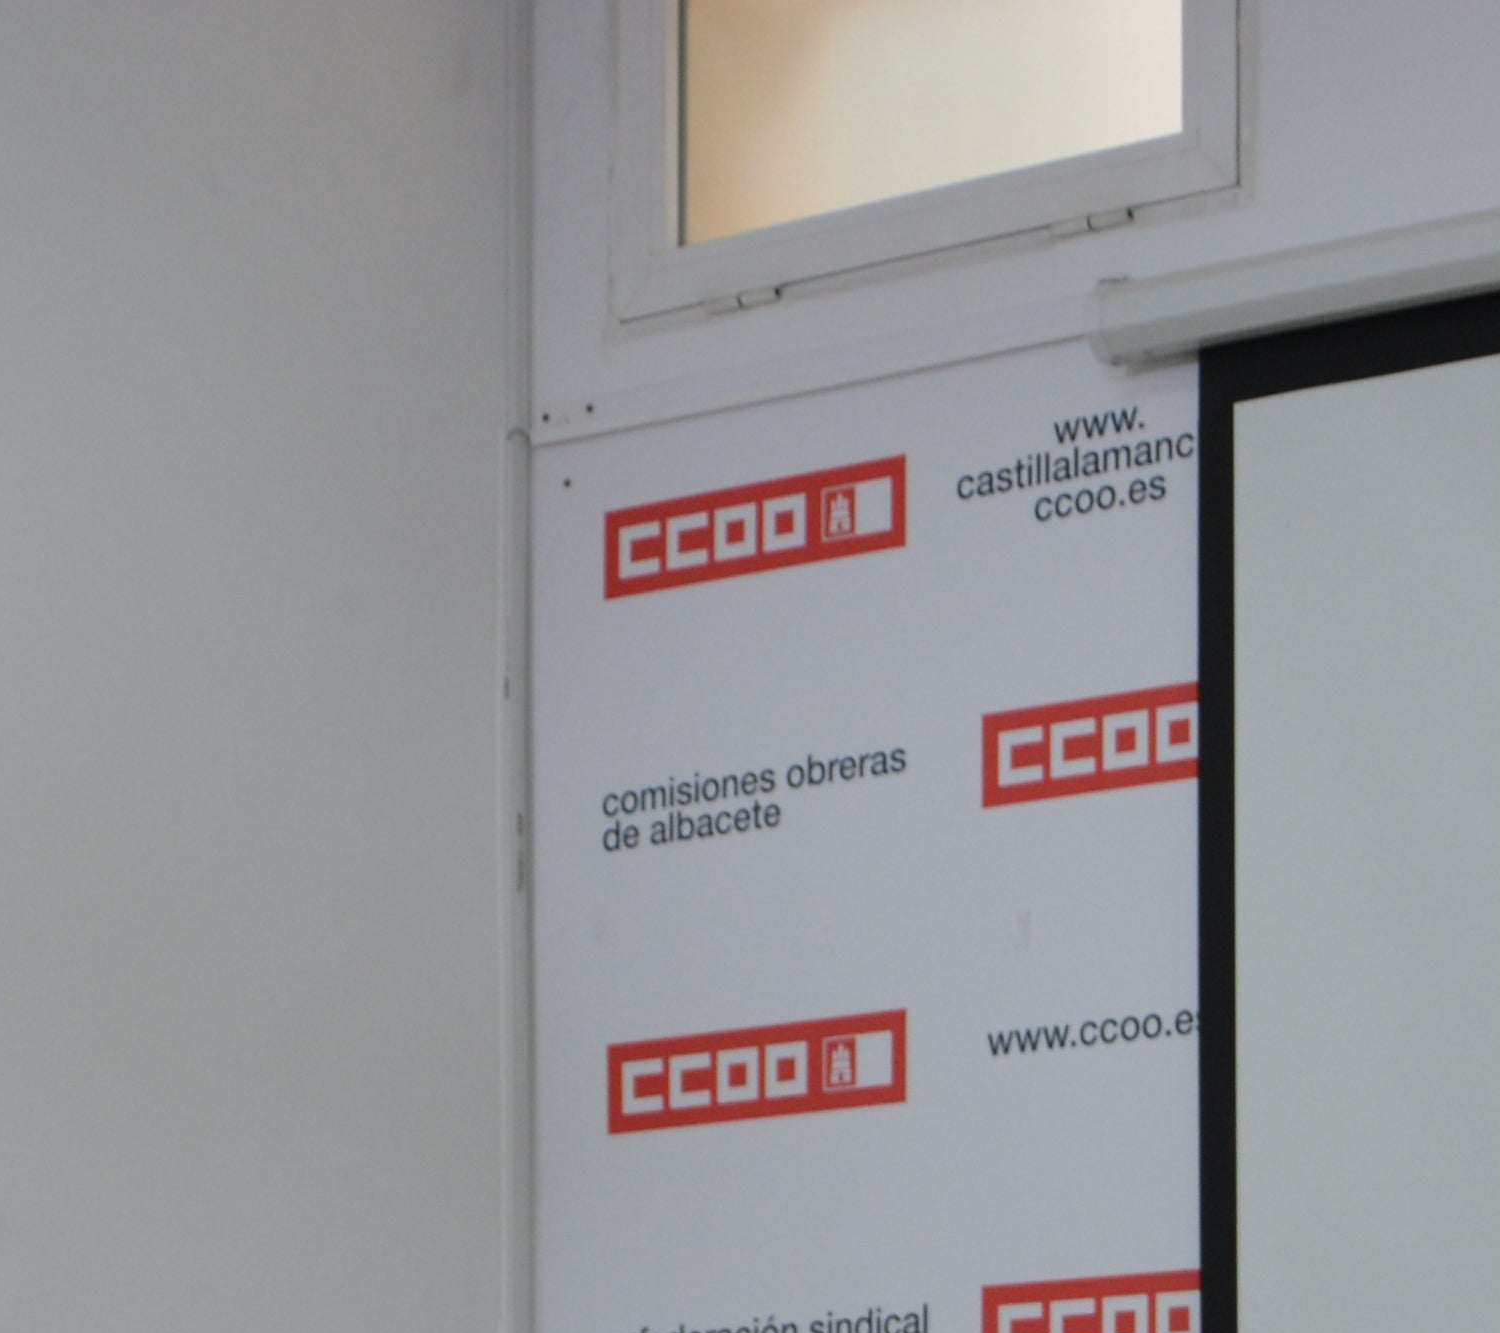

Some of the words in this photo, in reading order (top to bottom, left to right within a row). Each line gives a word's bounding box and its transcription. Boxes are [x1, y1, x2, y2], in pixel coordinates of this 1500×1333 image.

[1053, 406, 1145, 445] www.
[956, 432, 1195, 505] castillalamanc
[1033, 474, 1167, 523] ccoo.es
[618, 493, 807, 580] CCOO
[998, 703, 1198, 787] CCOO
[601, 768, 777, 819] comisiones
[785, 747, 907, 790] obreras
[602, 819, 641, 853] de
[649, 799, 782, 846] albacete
[988, 1007, 1200, 1056] www.ccoo.e
[621, 1041, 808, 1115] CCOO
